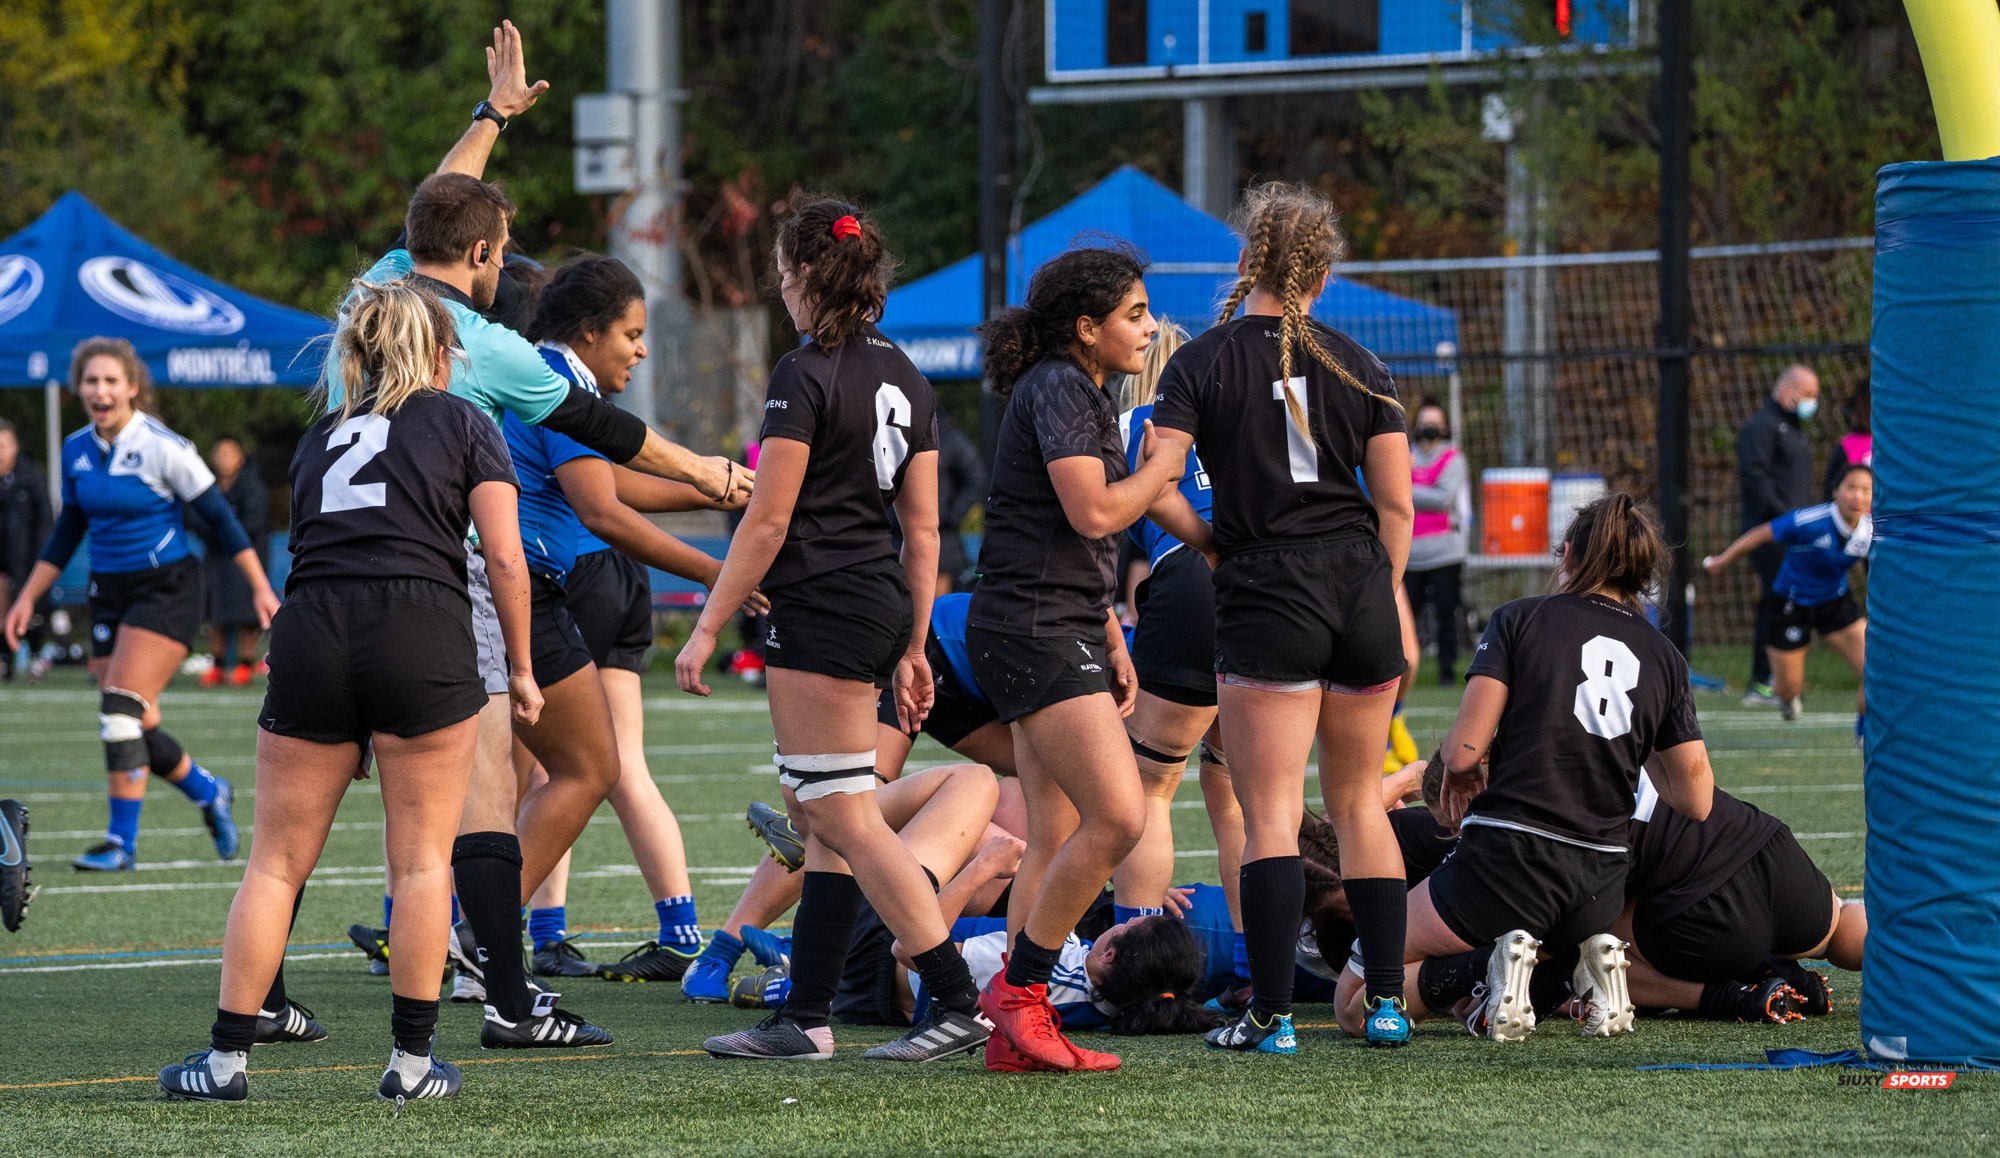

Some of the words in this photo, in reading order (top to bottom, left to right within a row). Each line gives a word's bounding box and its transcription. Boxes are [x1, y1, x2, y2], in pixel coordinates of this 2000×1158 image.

[320, 413, 391, 513] 2
[872, 382, 911, 490] 6
[1272, 376, 1319, 483] 1
[1573, 634, 1641, 740] 8
